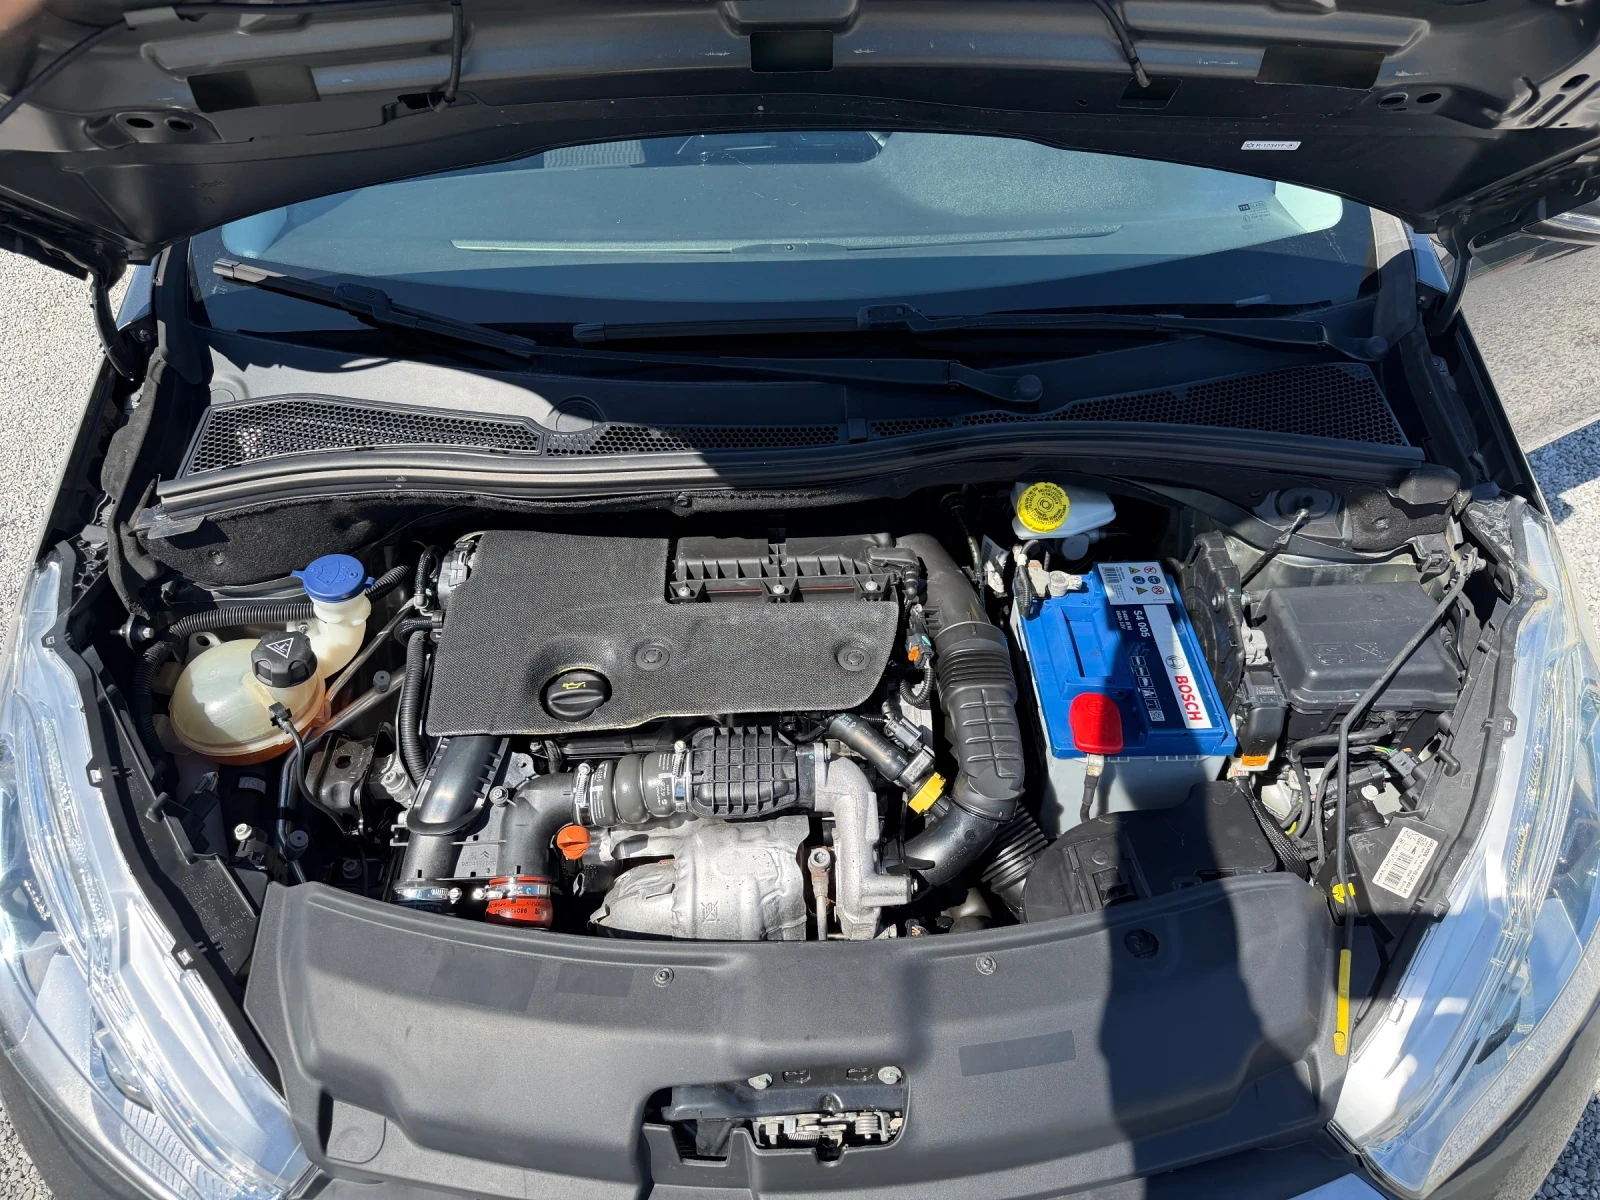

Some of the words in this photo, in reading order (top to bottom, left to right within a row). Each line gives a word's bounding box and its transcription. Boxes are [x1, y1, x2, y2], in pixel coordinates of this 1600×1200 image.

[1133, 610, 1145, 620] S4
[1138, 622, 1150, 637] 005
[1174, 675, 1203, 721] BOSCH
